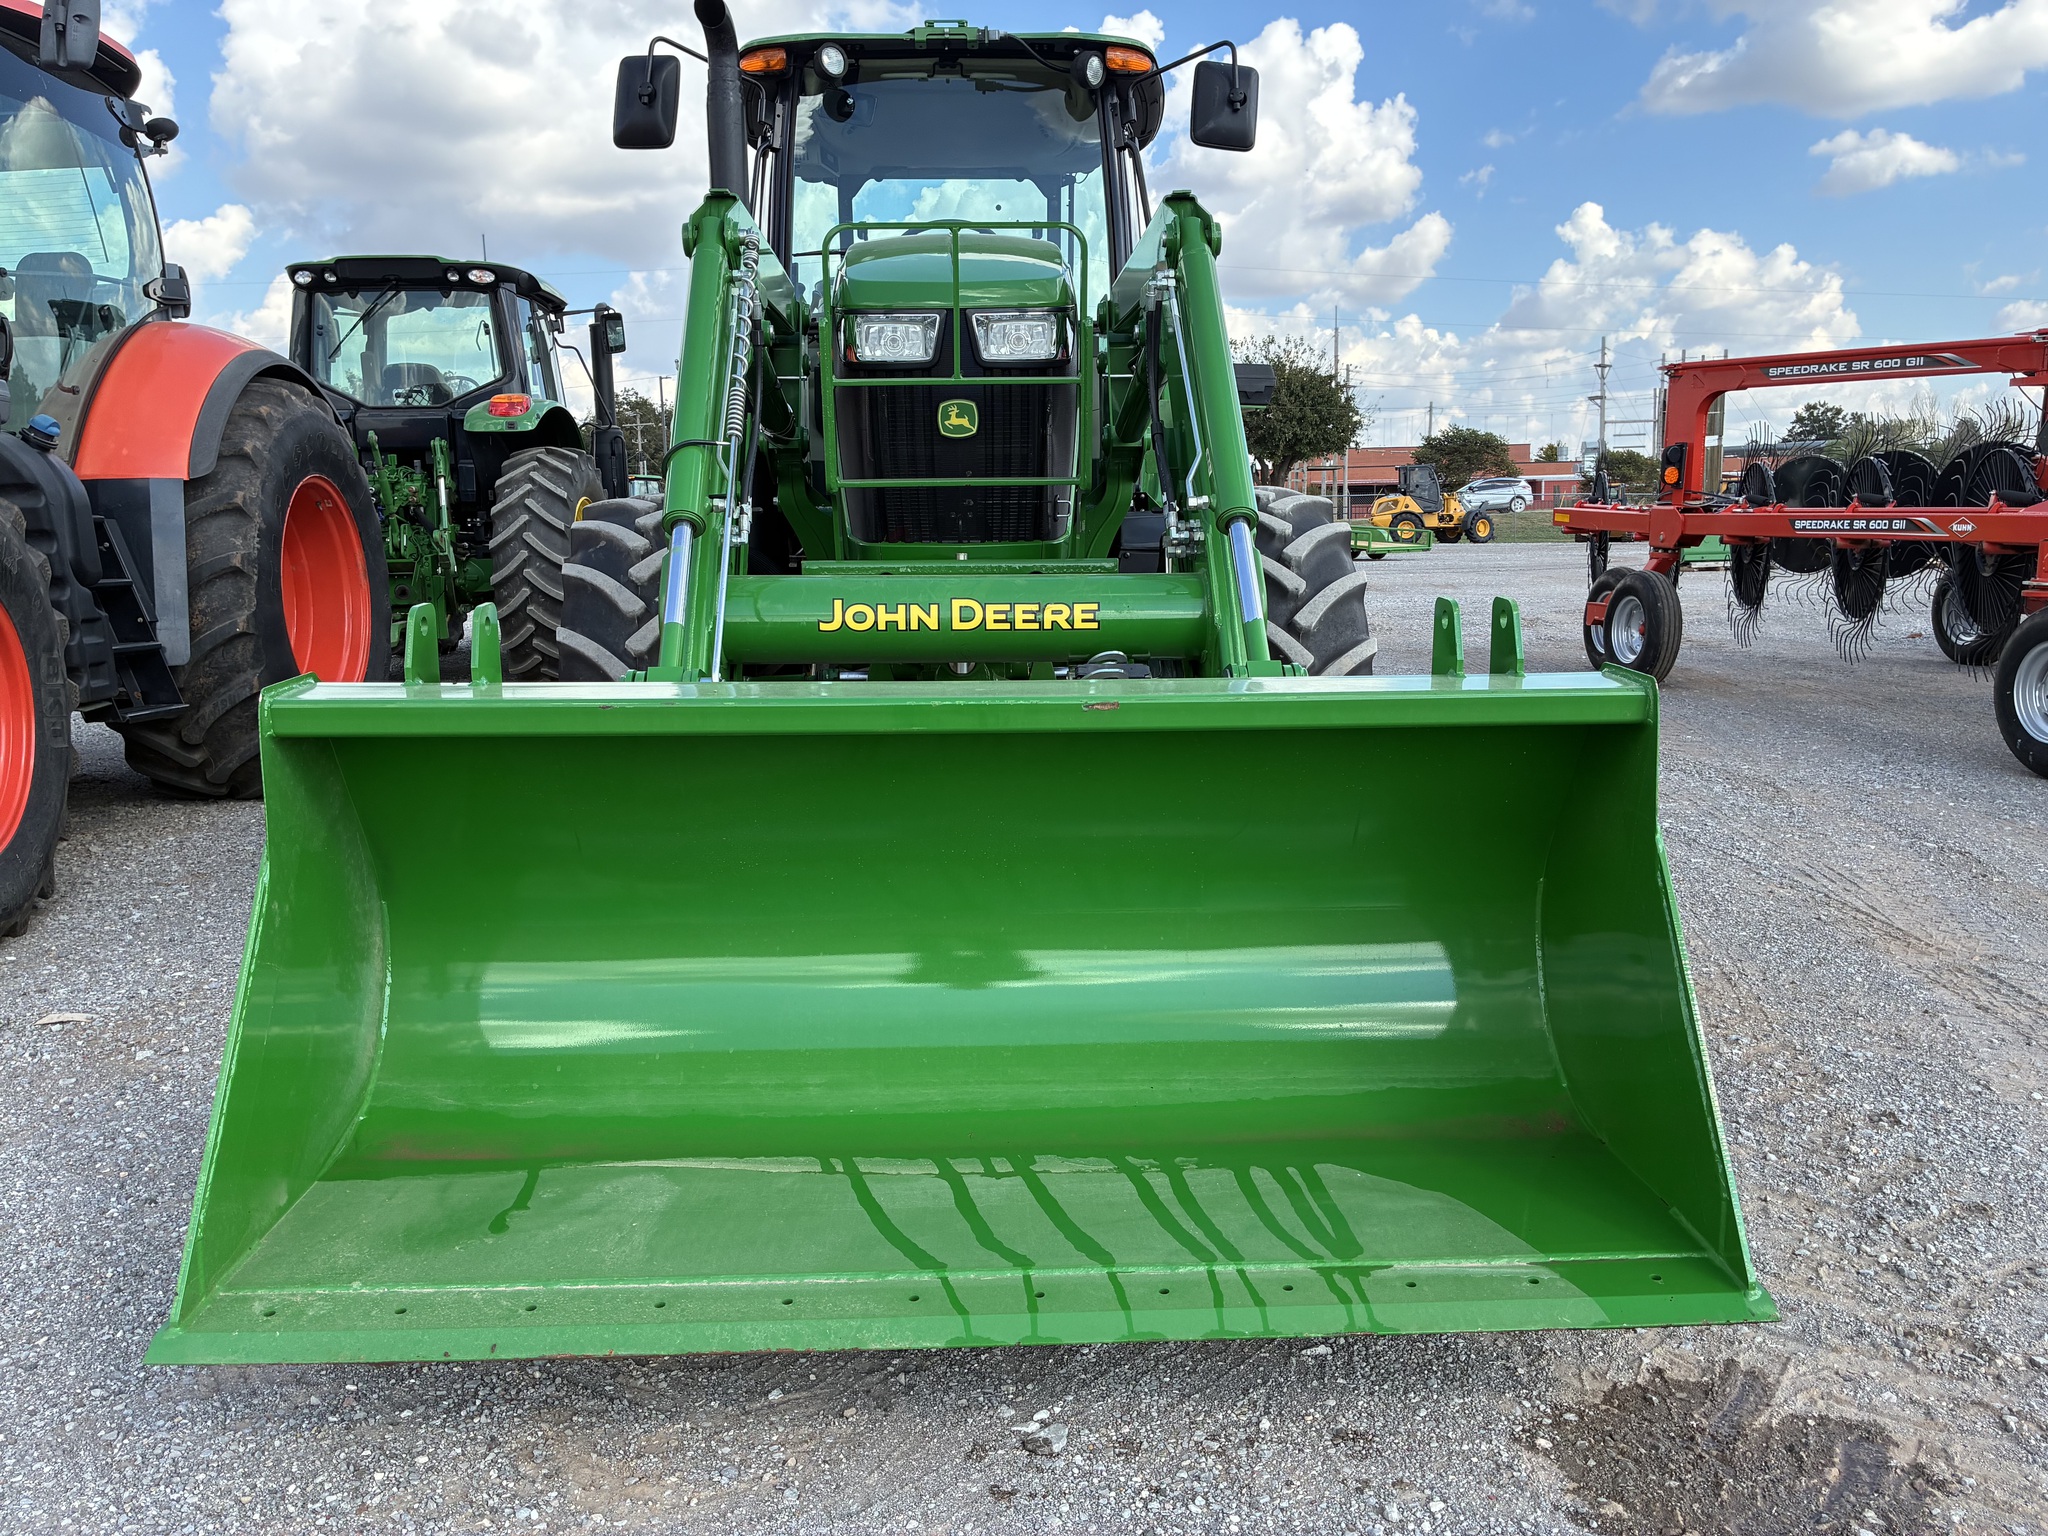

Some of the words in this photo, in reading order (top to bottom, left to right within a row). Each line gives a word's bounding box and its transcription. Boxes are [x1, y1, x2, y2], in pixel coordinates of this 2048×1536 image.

[1768, 363, 1848, 376] SPEEDRAKE
[1851, 361, 1870, 370] SR
[1873, 358, 1901, 369] 600
[1905, 356, 1924, 367] GII
[1794, 520, 1850, 529] SPEEDRAKE
[1852, 520, 1867, 529] SR
[1868, 519, 1889, 529] 600
[1892, 519, 1906, 529] GII
[1952, 523, 1972, 532] KUHN
[818, 598, 940, 632] JOHN
[950, 597, 1100, 631] DEERE
